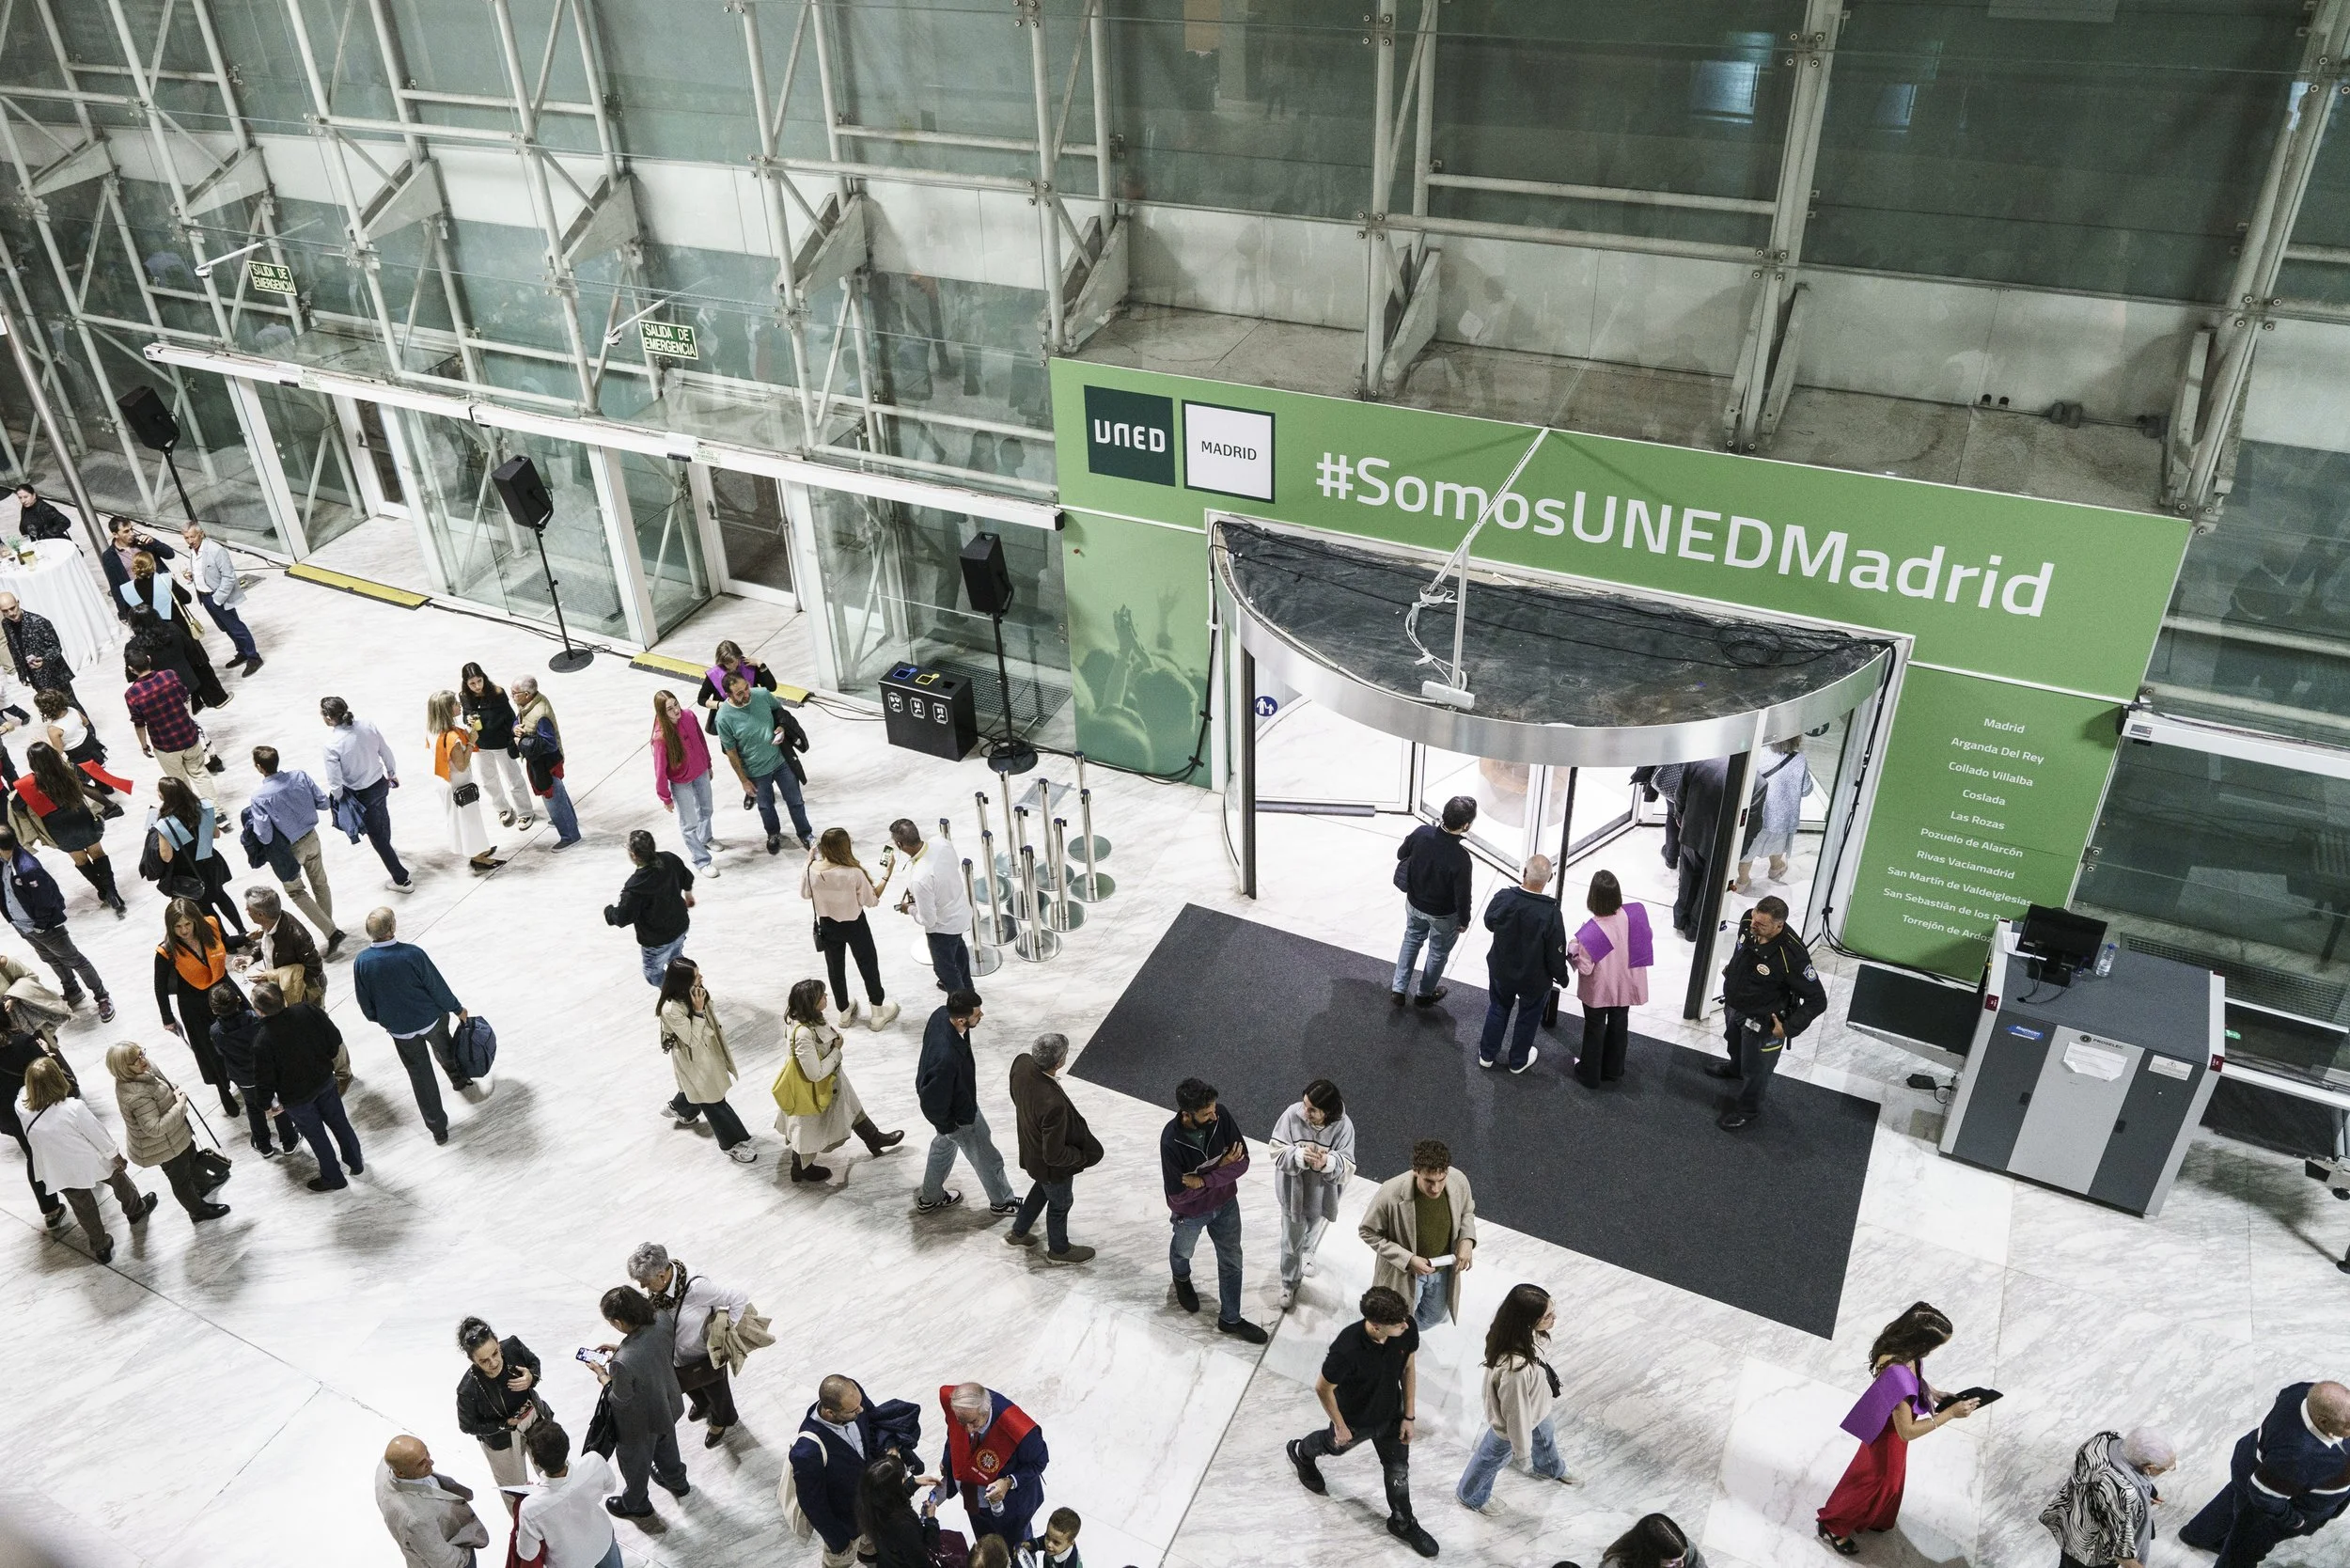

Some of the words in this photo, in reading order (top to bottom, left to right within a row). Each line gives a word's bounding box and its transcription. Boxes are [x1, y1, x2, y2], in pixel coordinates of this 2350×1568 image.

[253, 263, 275, 277] SALIDA
[276, 267, 288, 279] DE
[645, 323, 673, 339] SALIDA
[677, 328, 690, 341] DE
[644, 337, 696, 356] EMERGENCIA
[1094, 418, 1166, 453] UNED
[1201, 440, 1258, 461] MADRID
[1316, 451, 2056, 618] #SomosUNEDMadrid
[1983, 717, 2026, 734] Madrid
[1950, 737, 1998, 755] Arganda
[2000, 746, 2021, 759] Del
[2022, 751, 2044, 765] Rey
[1949, 761, 1990, 777] Collado
[1992, 770, 2034, 787] Villalba
[1962, 789, 2006, 806] Coslada
[1950, 810, 1970, 823] Las
[1971, 815, 2006, 830] Rozas
[1920, 827, 1964, 844] Pozuelo
[1965, 838, 1980, 848] de
[1981, 841, 2024, 857] Alarcón
[1917, 850, 1946, 864] Rivas
[1948, 856, 2015, 880] Vaciamadrid
[1887, 866, 1907, 878] San
[1909, 871, 1945, 886] Martín
[1946, 880, 1961, 890] de
[1963, 884, 2033, 907] Valdeiglesias
[1883, 887, 1903, 900] San
[1904, 893, 1956, 912] Sebastián
[1958, 905, 1972, 916] de
[1974, 909, 1991, 920] los
[1902, 914, 1945, 932] Torrejón
[1947, 926, 1961, 935] de
[1961, 929, 1994, 943] Ardoz
